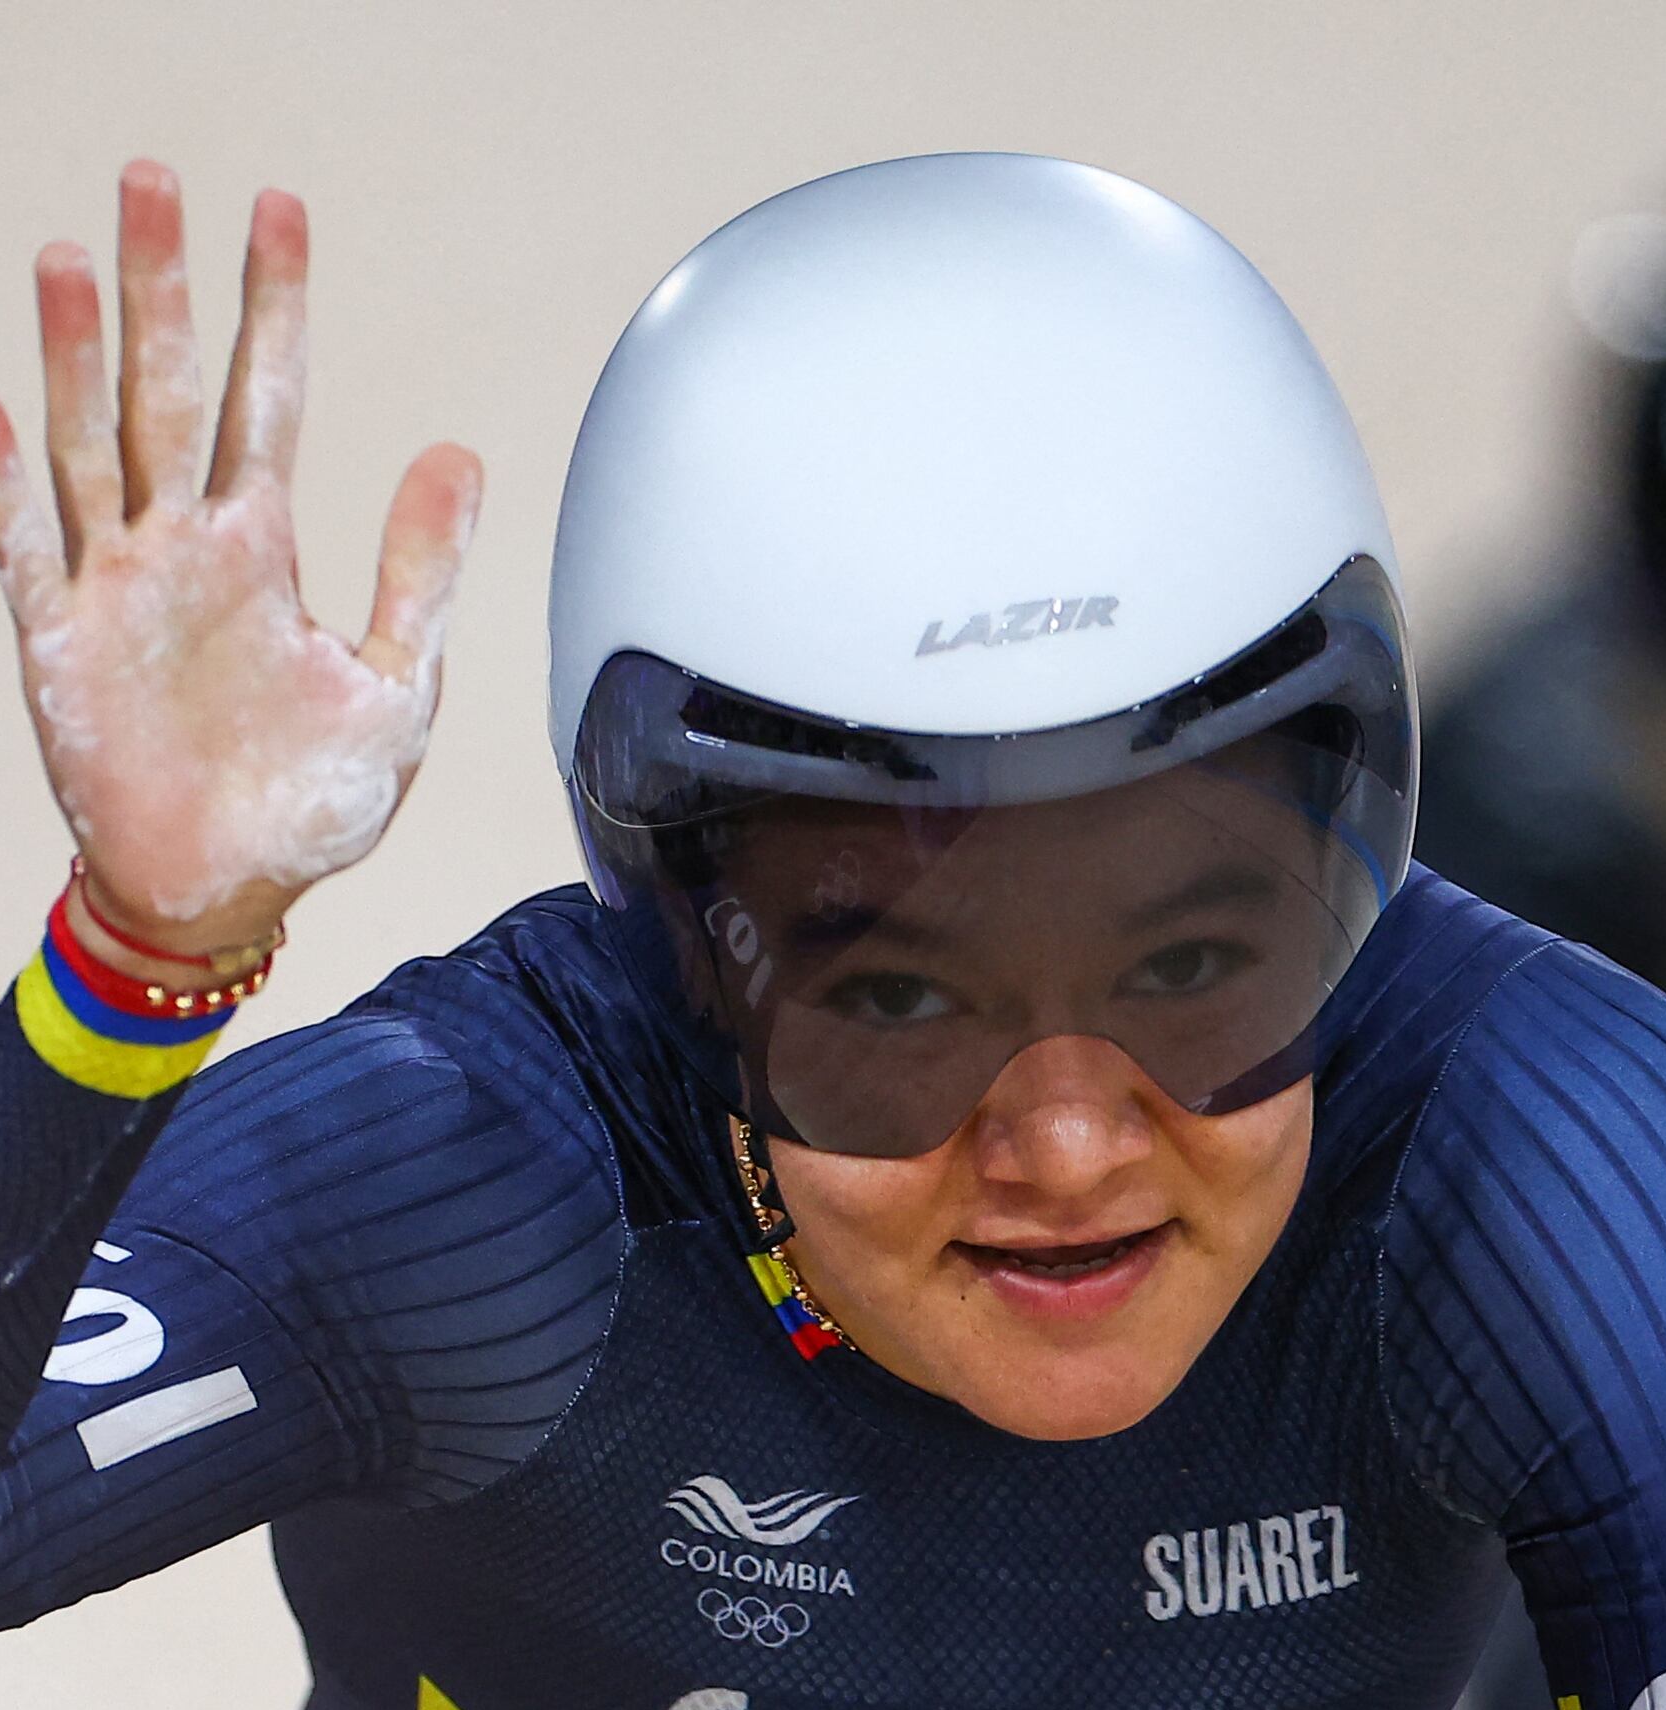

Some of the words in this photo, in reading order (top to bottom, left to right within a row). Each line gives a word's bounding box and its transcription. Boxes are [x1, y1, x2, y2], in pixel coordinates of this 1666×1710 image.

[41, 1238, 259, 1472] ol
[660, 1537, 856, 1598] COLOMBIA
[1143, 1503, 1360, 1622] SUAREZ
